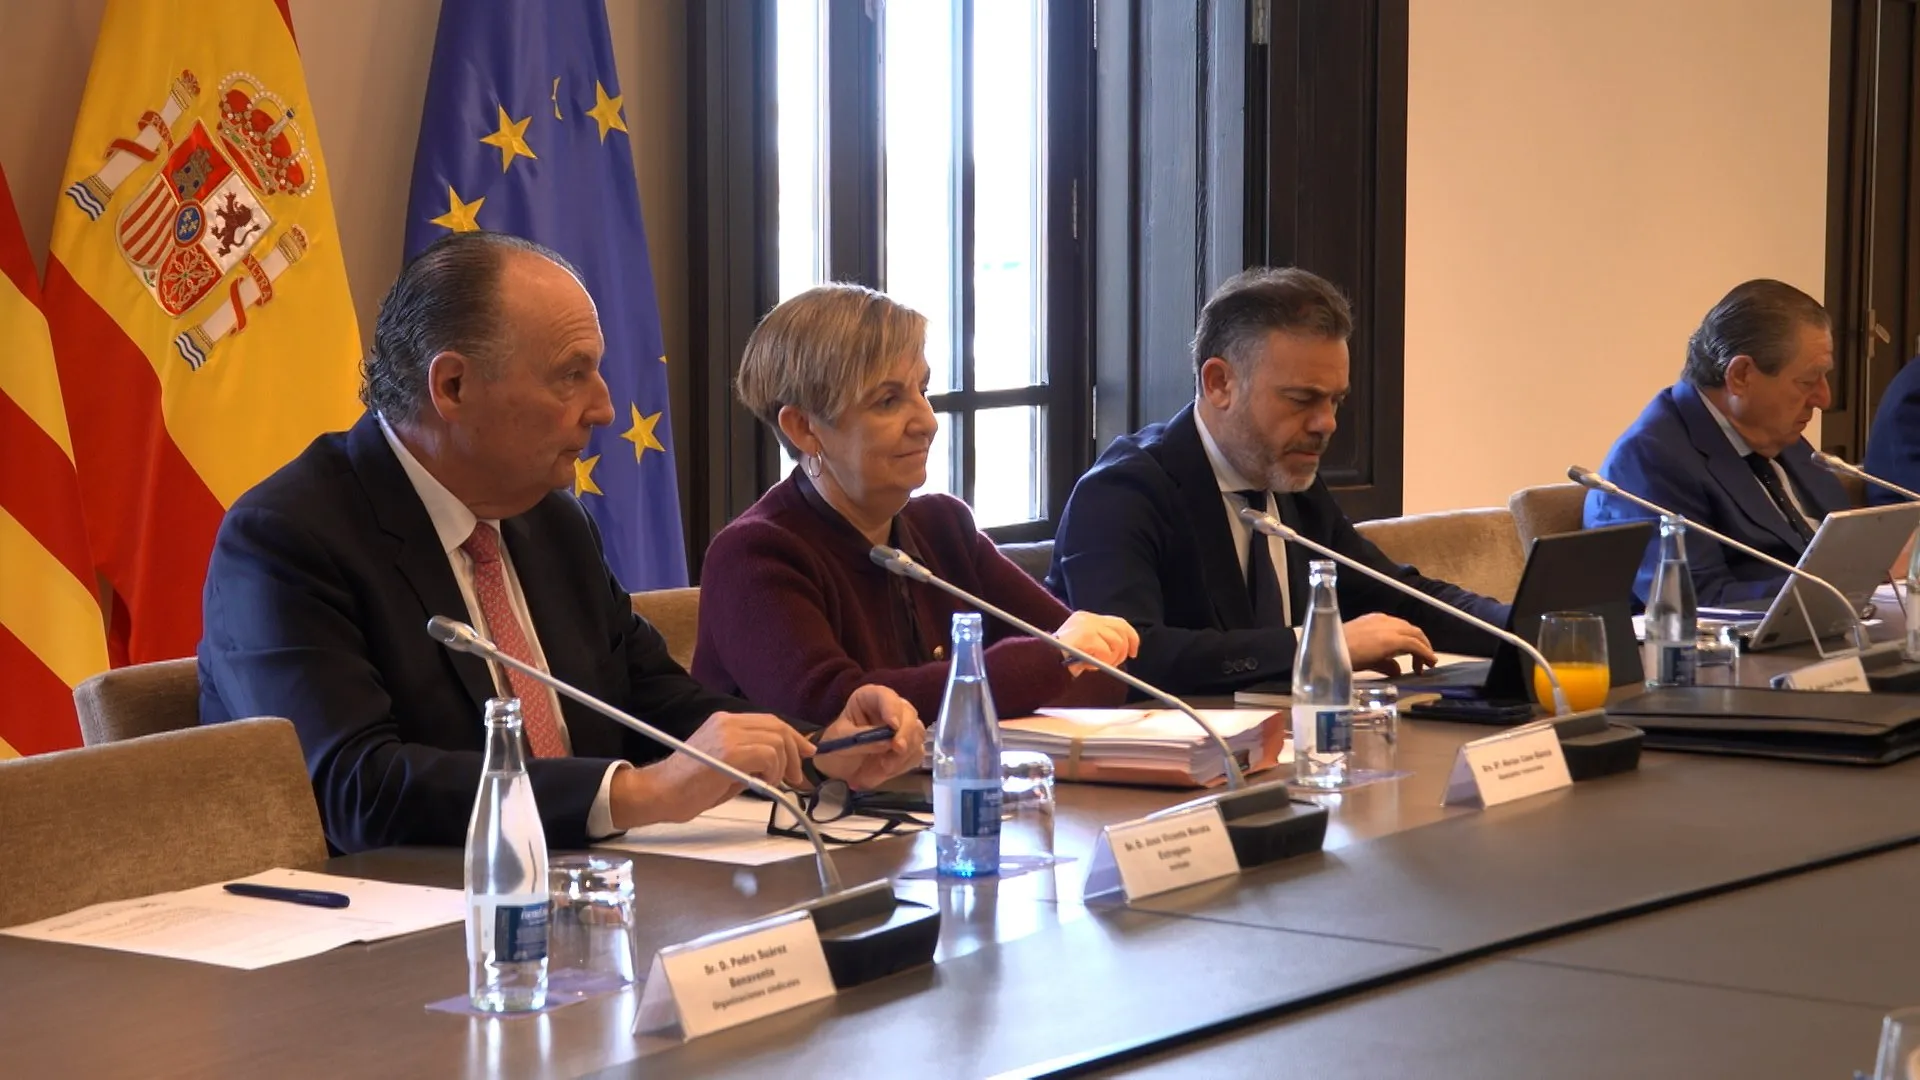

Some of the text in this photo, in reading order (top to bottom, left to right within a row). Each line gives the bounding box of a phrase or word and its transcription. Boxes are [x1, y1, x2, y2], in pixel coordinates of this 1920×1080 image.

[704, 944, 788, 975] Sr. D. Pedro Suárez
[729, 968, 775, 988] Benavente
[712, 979, 801, 1010] Organizaciones sindicales
